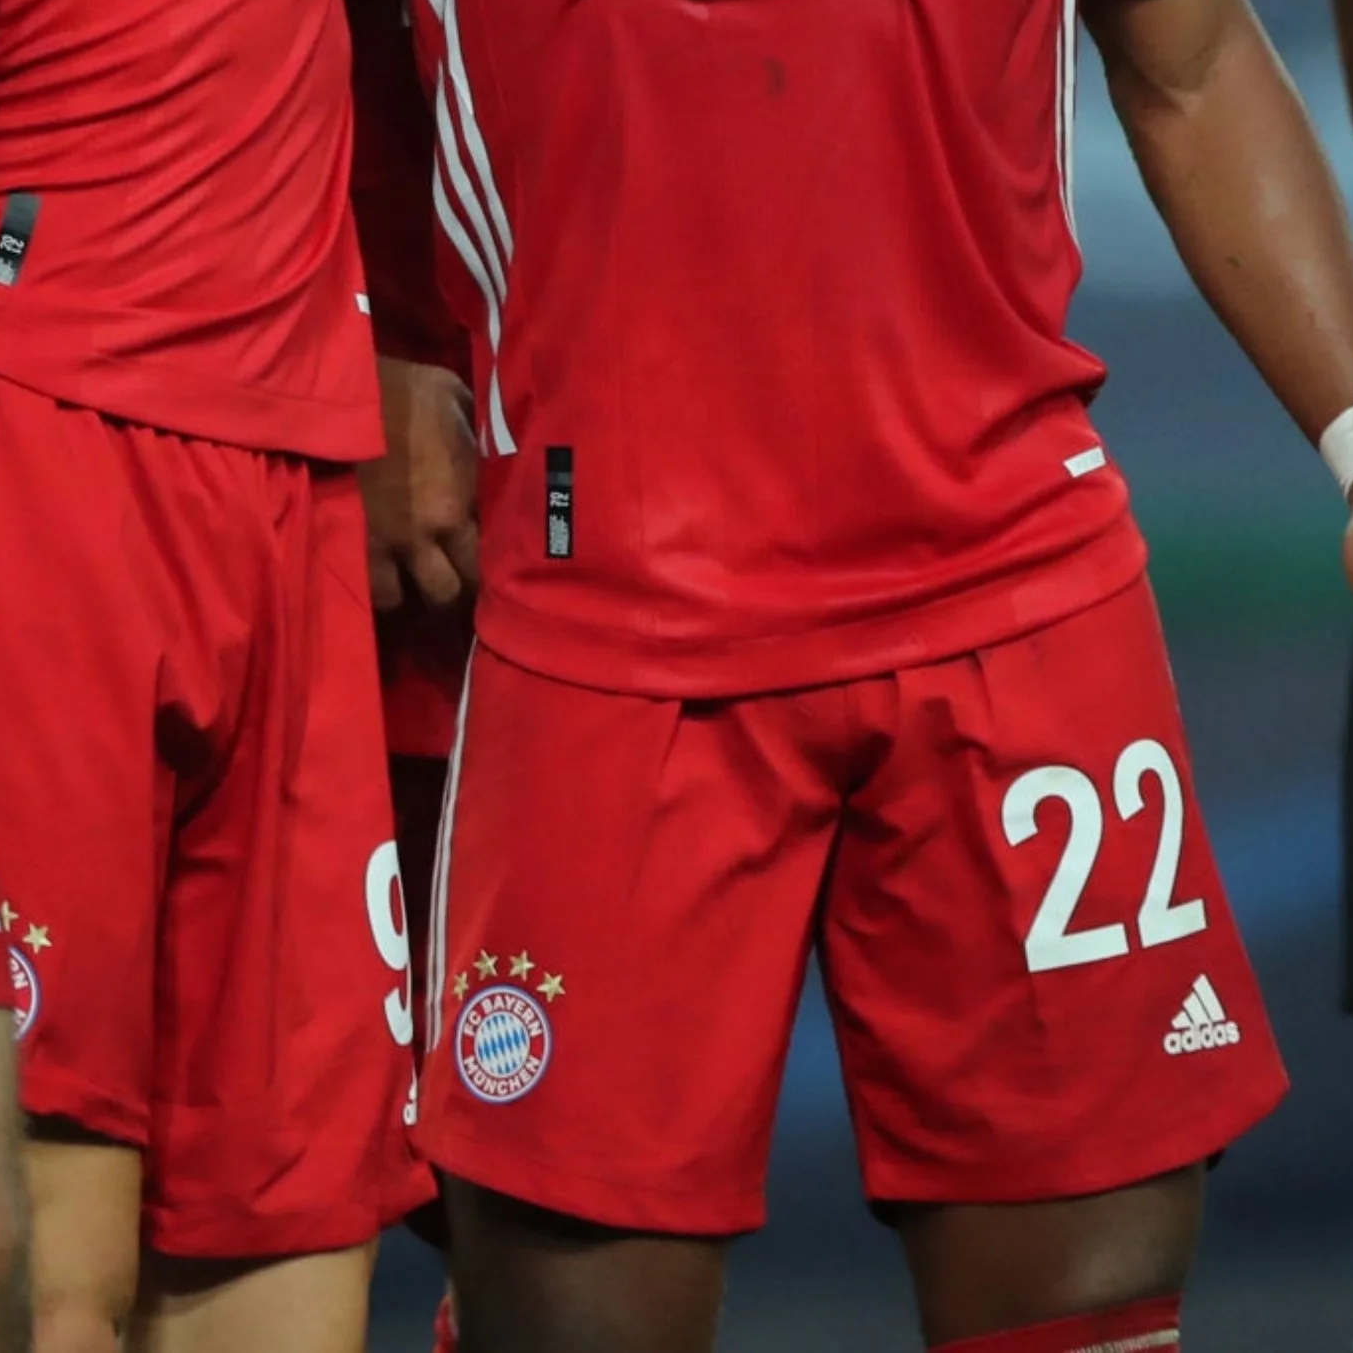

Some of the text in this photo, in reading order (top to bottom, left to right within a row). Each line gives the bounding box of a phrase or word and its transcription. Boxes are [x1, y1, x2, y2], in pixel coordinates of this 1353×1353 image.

[1001, 738, 1208, 973] 22
[365, 839, 414, 1046] 9
[464, 995, 543, 1037] FC BAYERN
[1163, 1020, 1241, 1056] adidas
